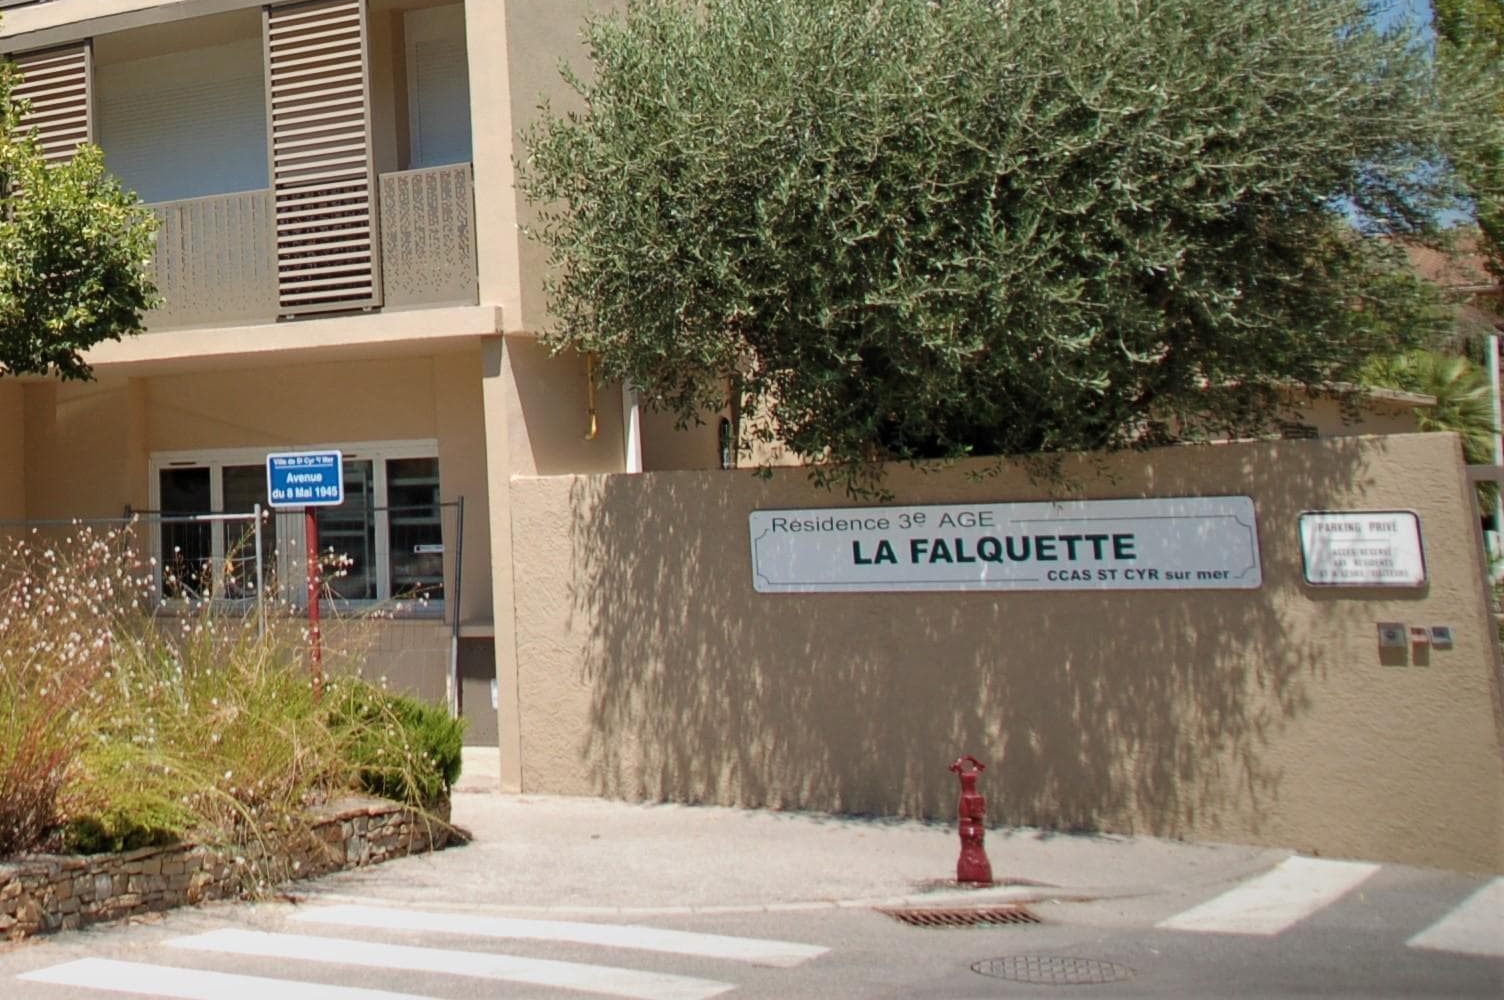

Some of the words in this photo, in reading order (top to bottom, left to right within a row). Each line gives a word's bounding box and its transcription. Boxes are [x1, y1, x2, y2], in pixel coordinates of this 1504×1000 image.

[286, 472, 323, 483] Avenue
[272, 488, 285, 499] du
[287, 487, 293, 498] 8
[295, 486, 312, 497] Mai
[315, 485, 338, 497] 1945
[939, 511, 995, 528] AGE
[1317, 521, 1362, 533] PARKING
[852, 540, 897, 565] LA
[910, 533, 1137, 564] FALQUETTE
[1047, 569, 1092, 581] CCAS
[1098, 568, 1118, 581] ST
[1124, 568, 1159, 581] CYR
[1165, 570, 1191, 581] sur
[1197, 569, 1229, 580] mer
